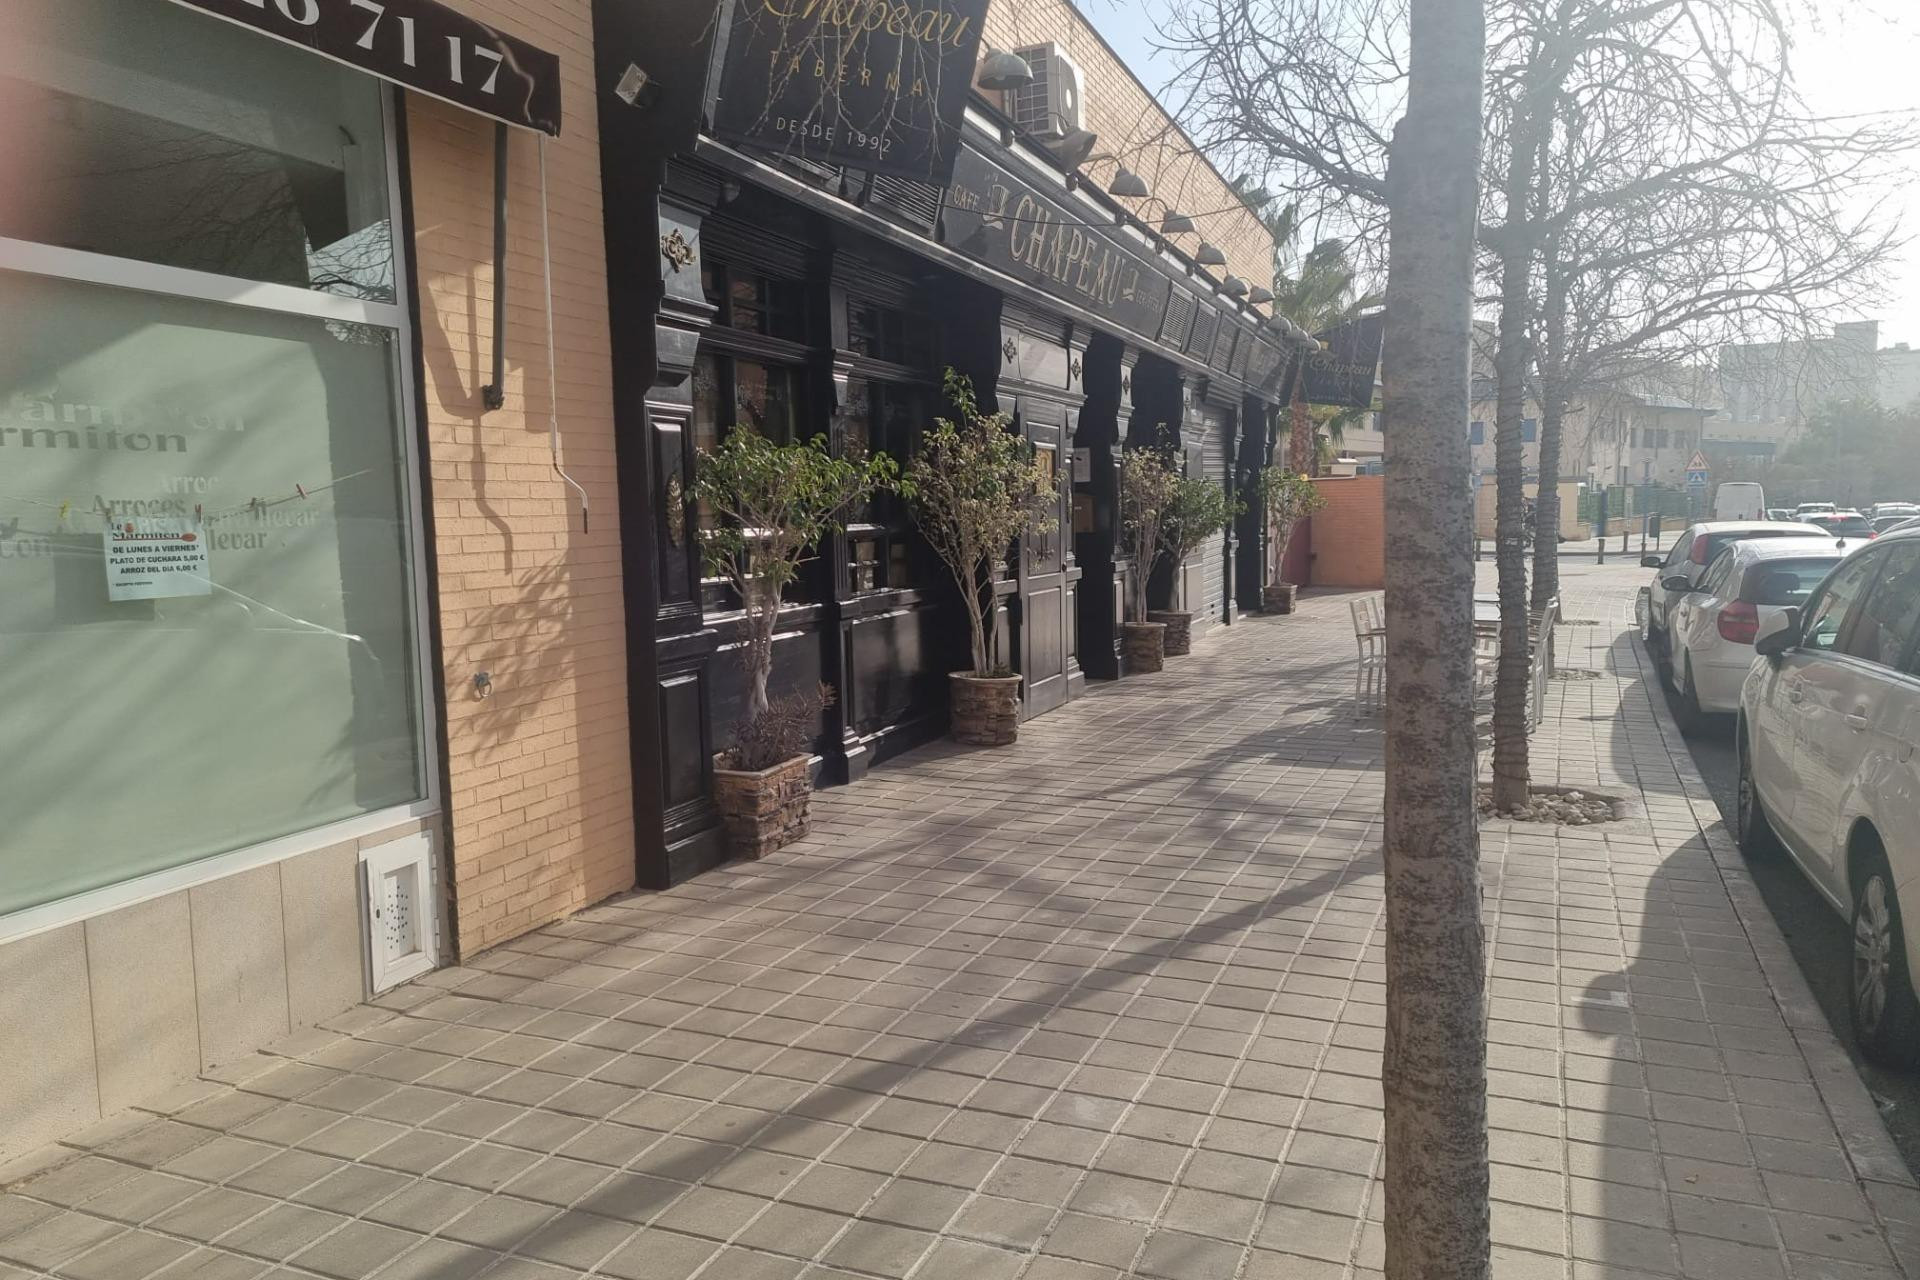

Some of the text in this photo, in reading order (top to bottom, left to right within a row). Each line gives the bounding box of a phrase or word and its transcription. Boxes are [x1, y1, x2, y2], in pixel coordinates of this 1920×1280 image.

[445, 36, 504, 95] 17
[770, 51, 924, 97] TABERNA
[776, 117, 893, 153] DESDE 1992
[1010, 194, 1126, 308] CHAPEAU
[110, 557, 135, 565] PLATO
[136, 556, 146, 564] DE
[147, 555, 182, 564] CUCHARA
[112, 546, 124, 554] DE
[126, 545, 152, 553] LUNES
[154, 545, 160, 553] A
[120, 567, 146, 575] ARROZ
